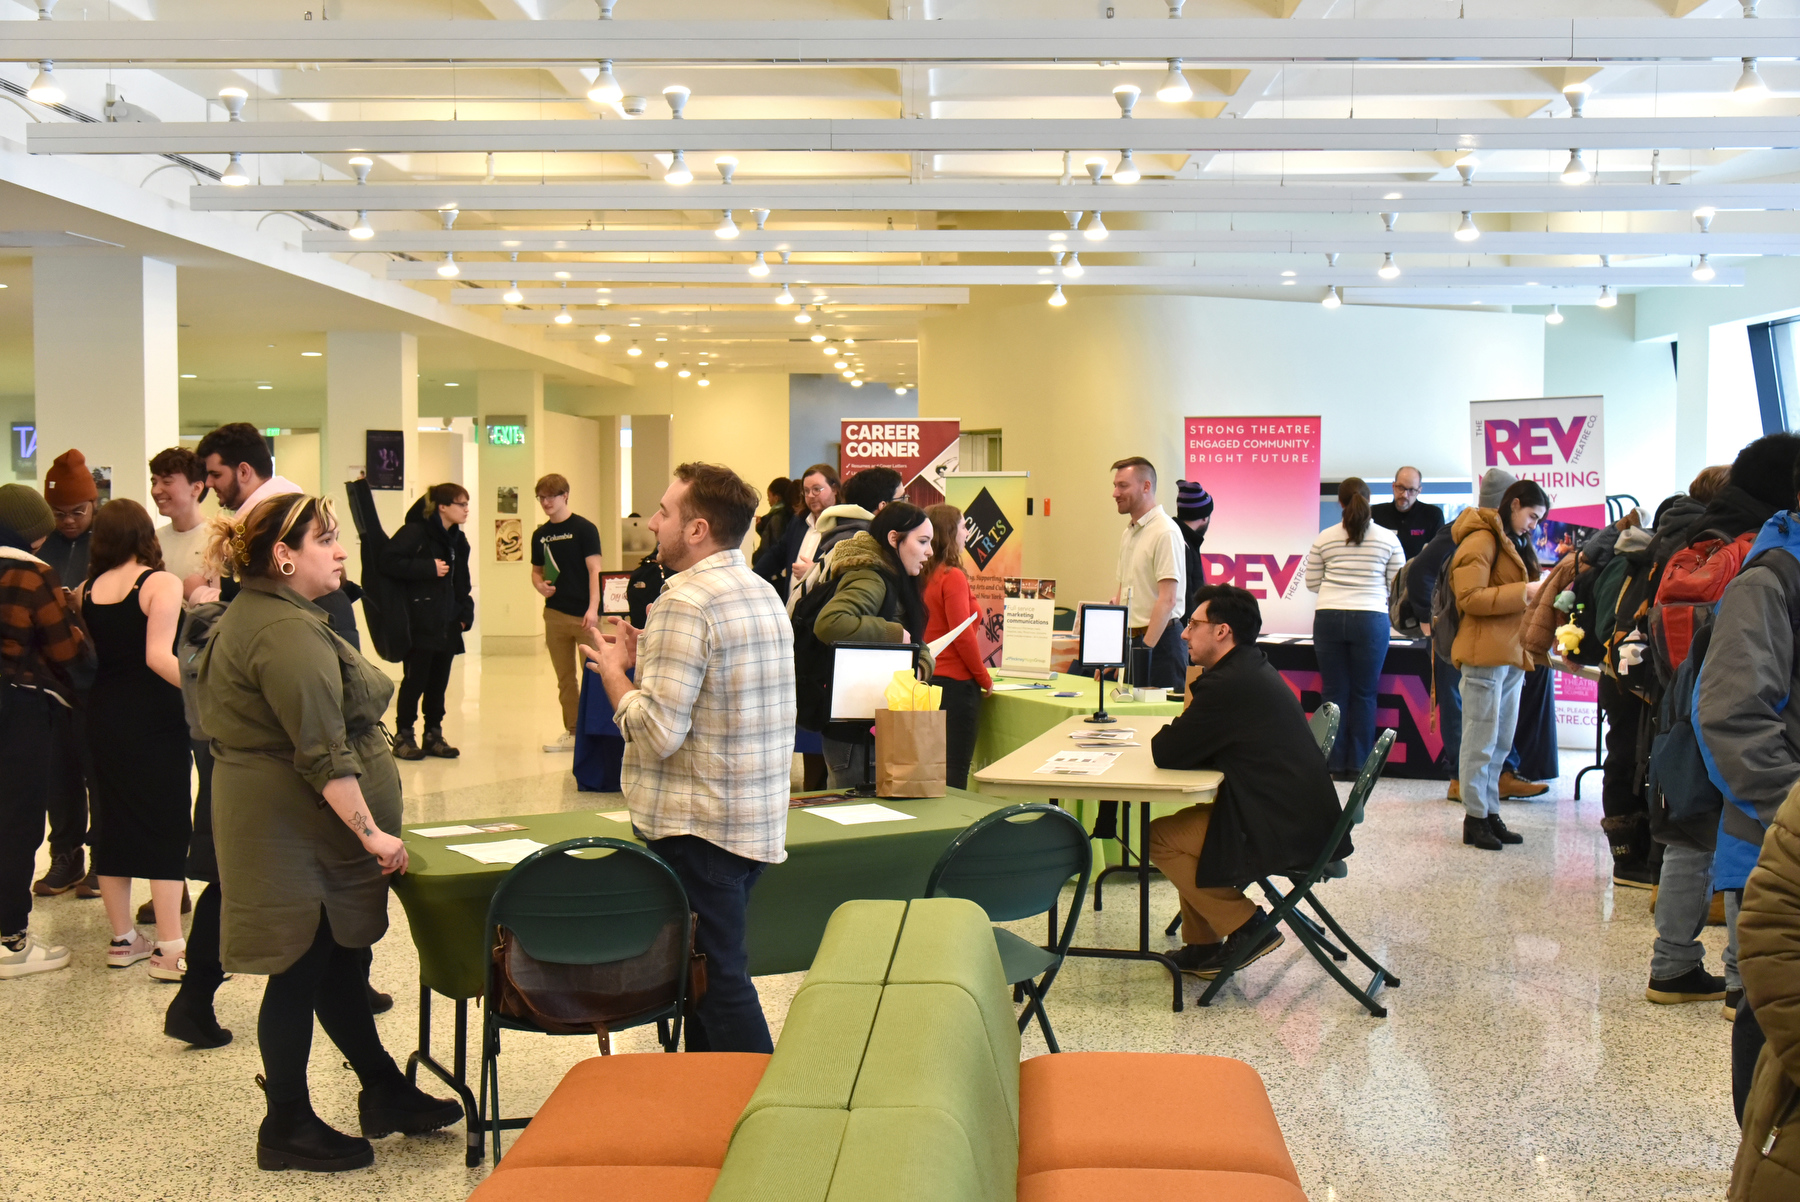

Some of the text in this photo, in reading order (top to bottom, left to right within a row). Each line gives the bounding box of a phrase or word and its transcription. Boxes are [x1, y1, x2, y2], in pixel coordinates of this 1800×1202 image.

[493, 425, 520, 444] EXIT
[845, 424, 920, 440] CAREER
[1189, 425, 1316, 434] STRONG THEATRE.
[845, 441, 920, 457] CORNER
[1189, 440, 1240, 449] ENGAGED
[1484, 416, 1588, 466] REV
[1571, 430, 1591, 465] THEATRE
[1189, 454, 1315, 463] BRIGHT FUTURE.
[1533, 471, 1600, 487] HIRING
[545, 532, 573, 543] Columbia
[965, 516, 984, 548] CNY
[977, 519, 1007, 563] ARTS
[1284, 567, 1306, 601] THEATRE
